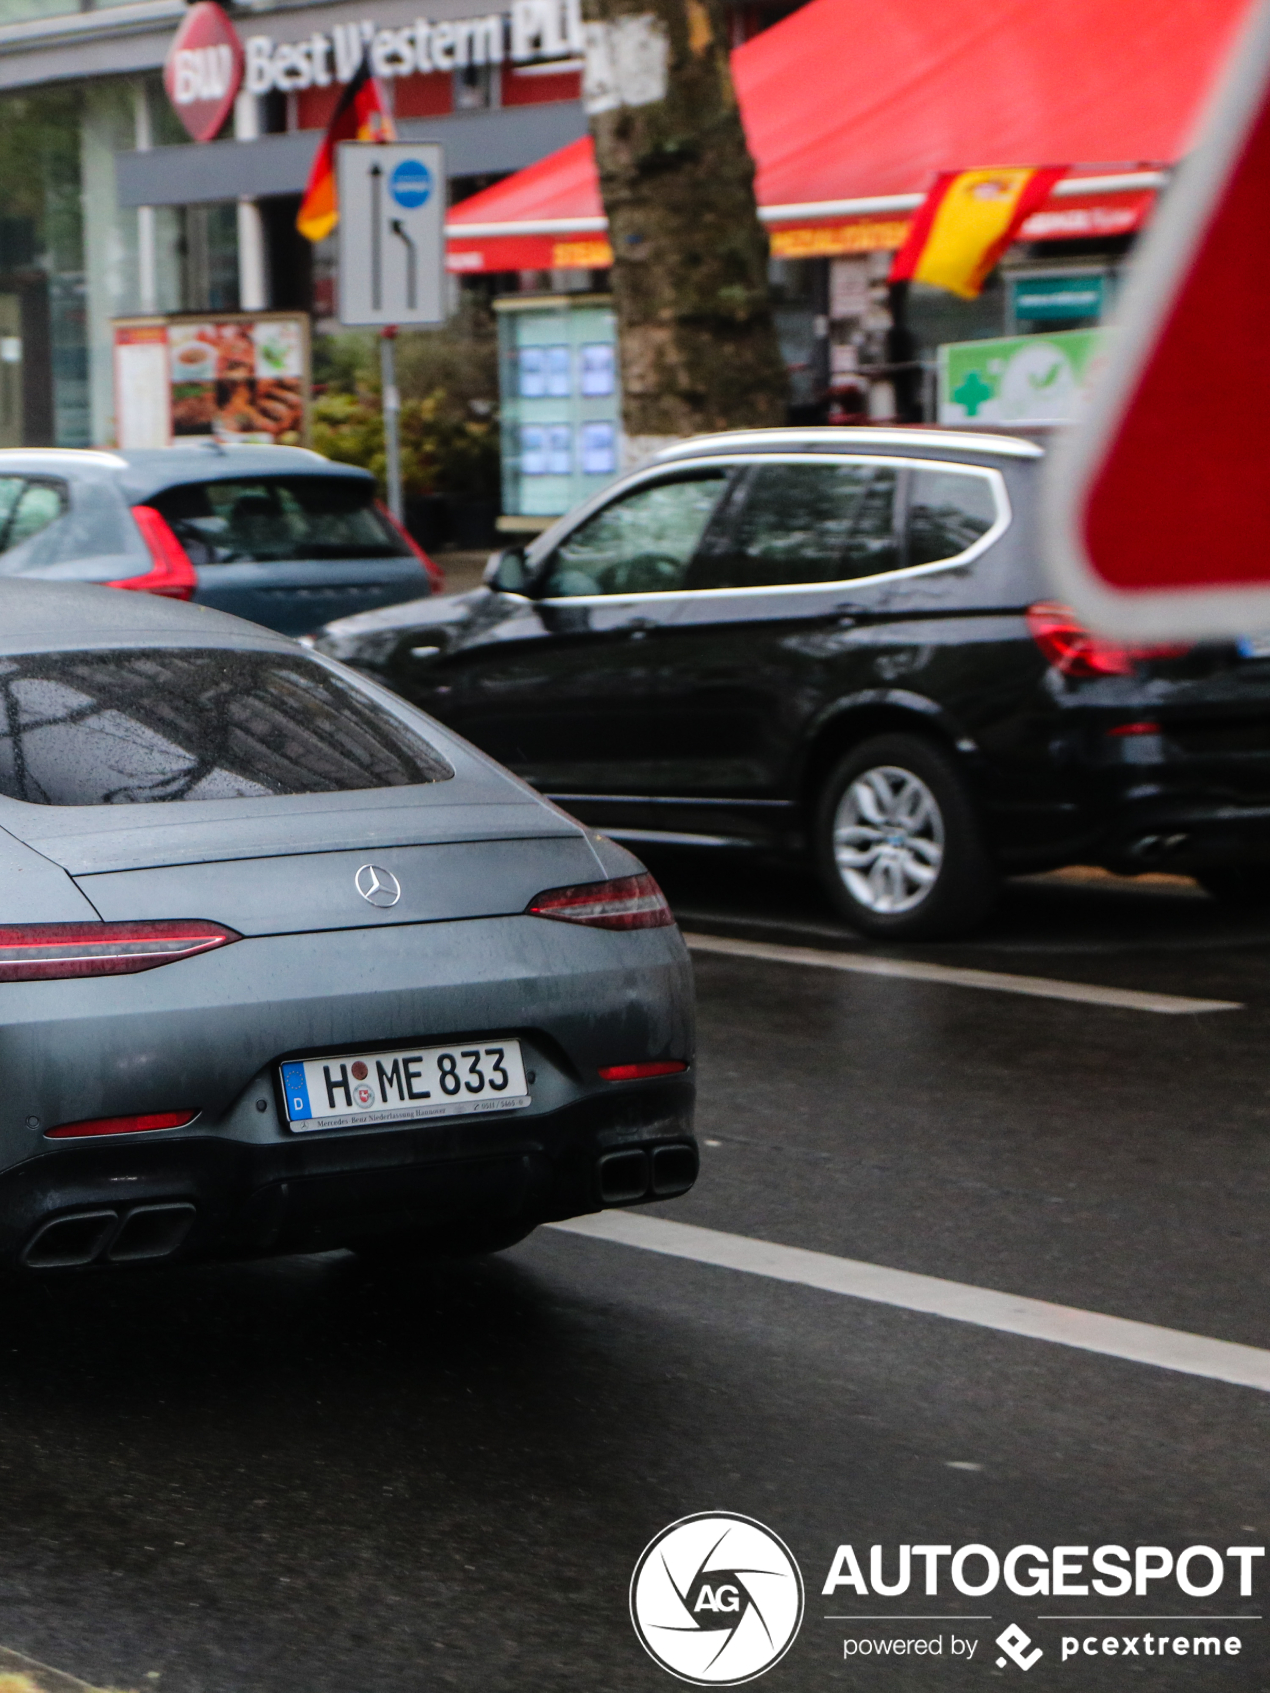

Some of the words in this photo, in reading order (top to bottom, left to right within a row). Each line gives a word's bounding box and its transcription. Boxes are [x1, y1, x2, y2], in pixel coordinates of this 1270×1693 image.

[245, 33, 331, 94] Best
[332, 15, 503, 83] Western
[323, 1064, 353, 1108] H
[376, 1056, 431, 1103] ME
[437, 1048, 509, 1095] 833
[293, 1097, 304, 1111] D
[369, 1110, 415, 1122] Niederlassung
[416, 1107, 446, 1117] Hannover
